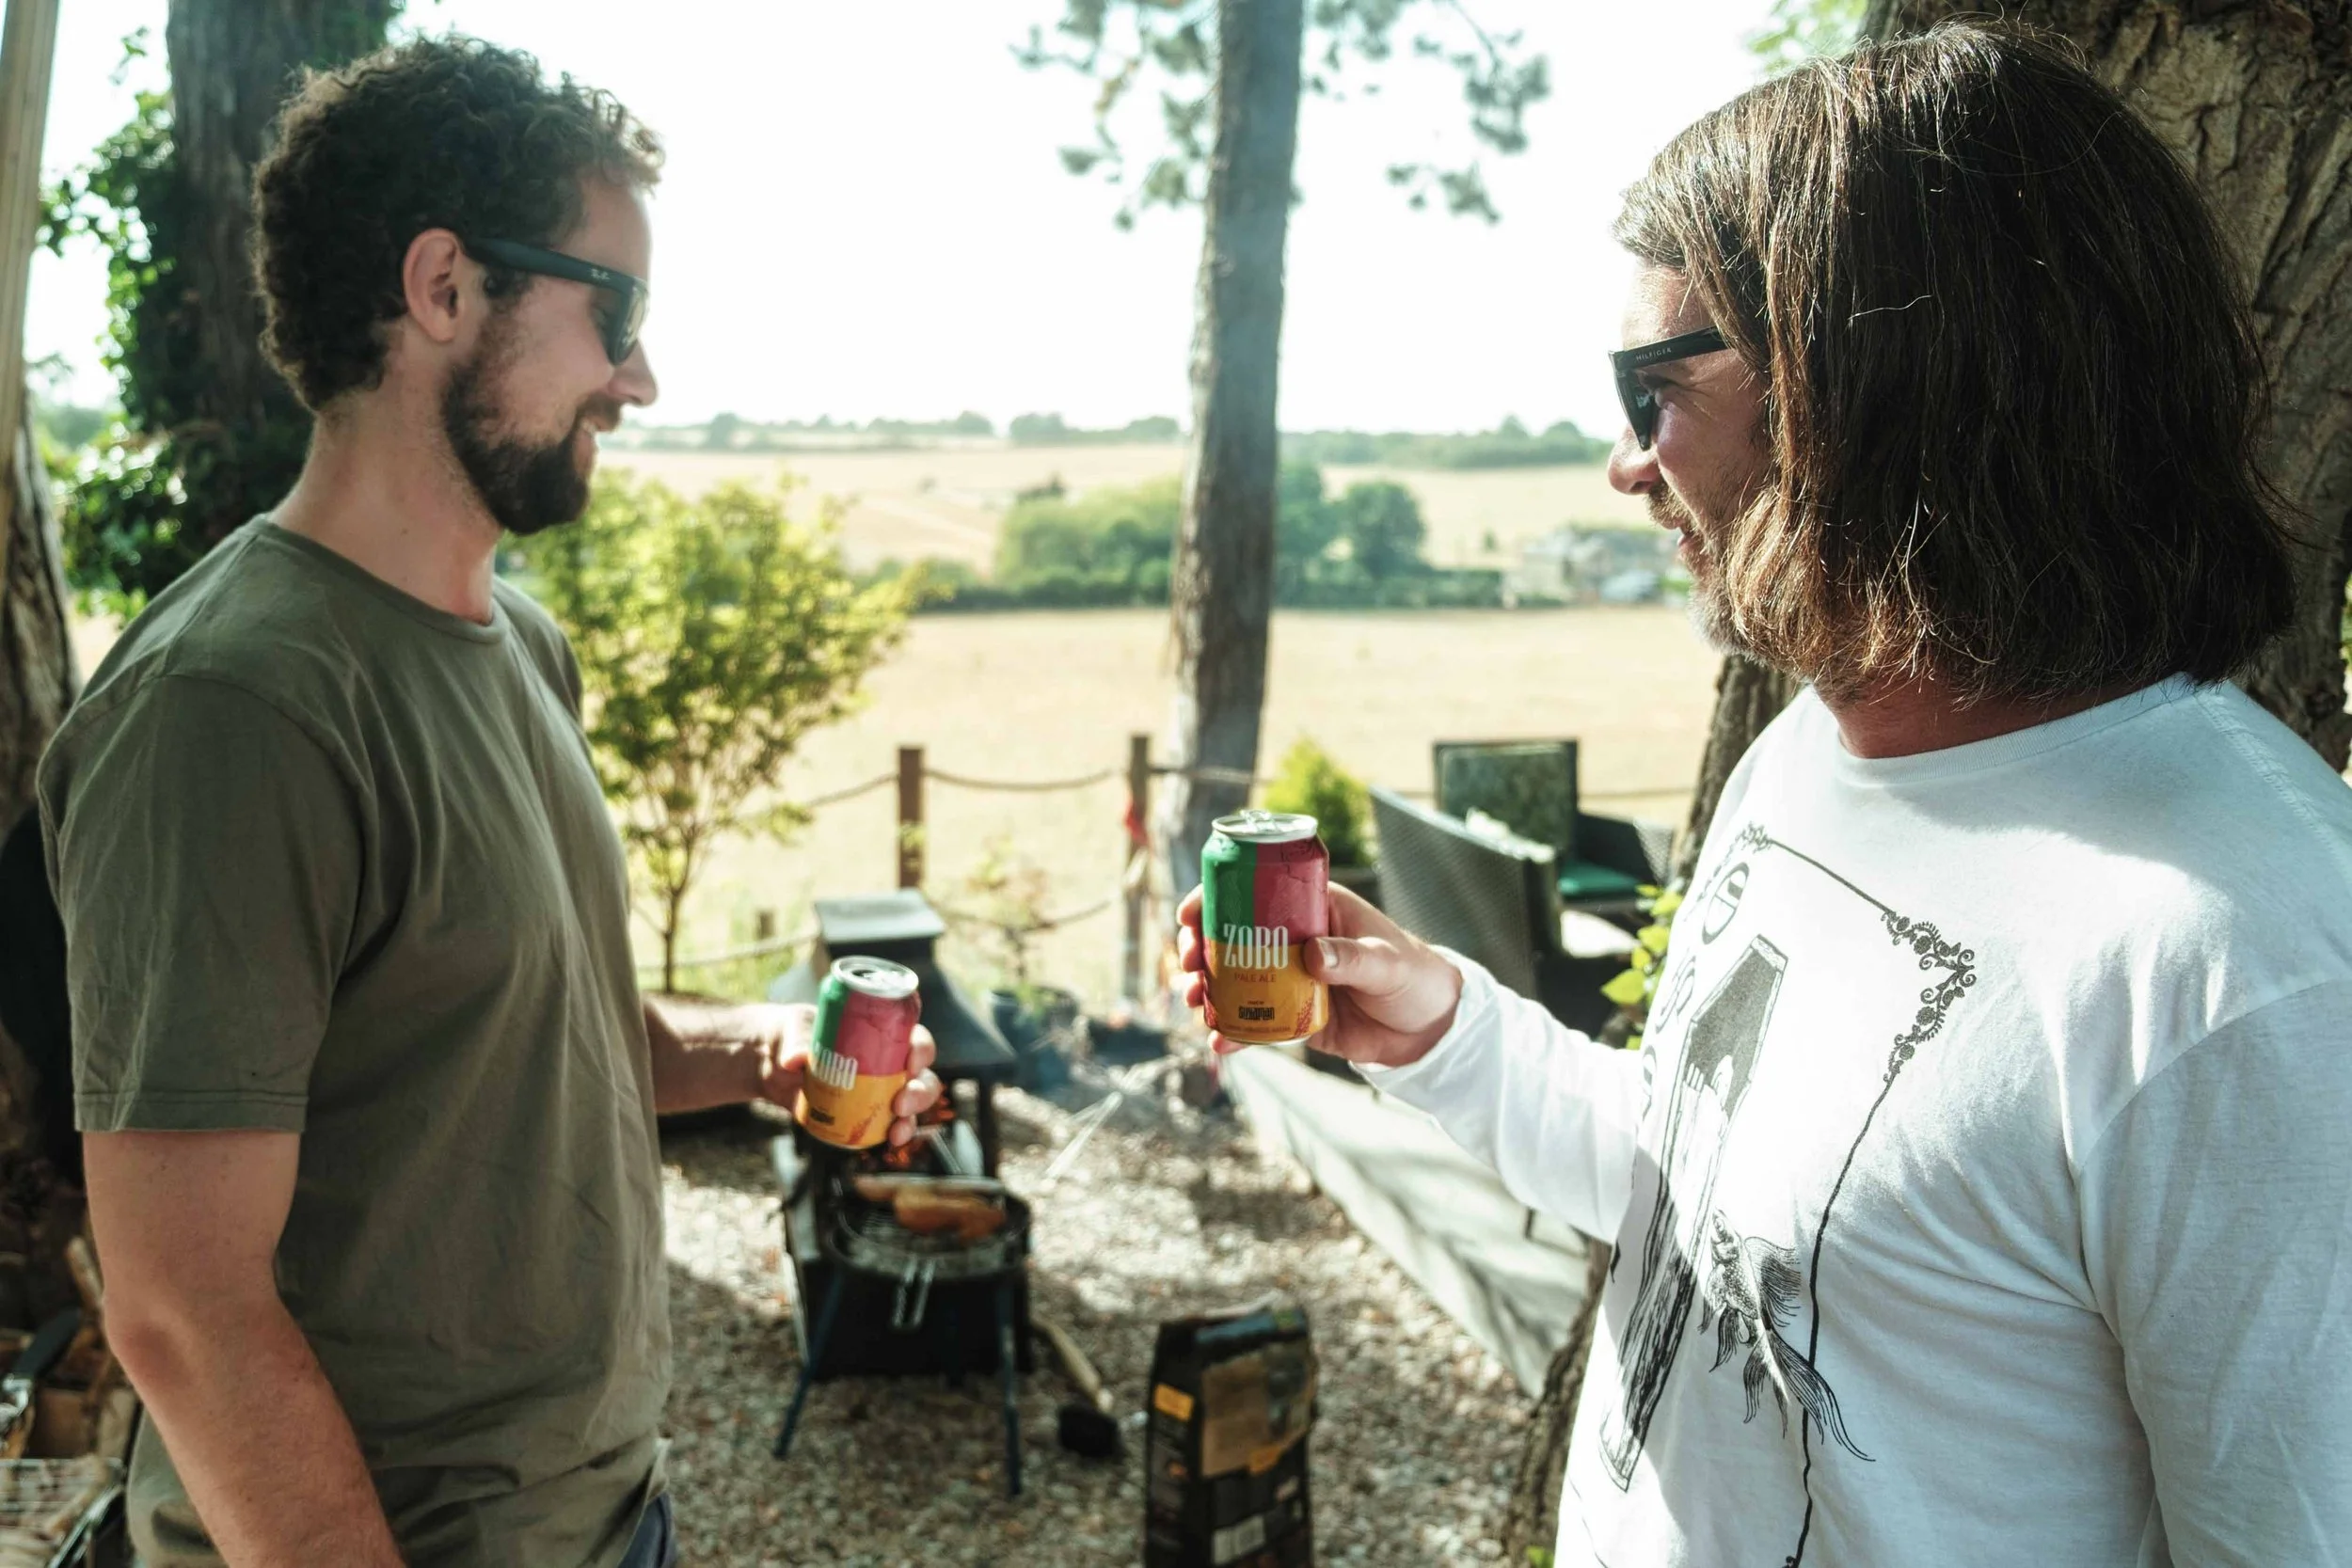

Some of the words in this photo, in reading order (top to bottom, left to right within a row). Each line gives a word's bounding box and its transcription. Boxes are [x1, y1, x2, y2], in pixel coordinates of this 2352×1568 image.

[1223, 923, 1289, 970] ZOBO
[1233, 972, 1257, 983] PALE
[1259, 974, 1277, 983] ALE
